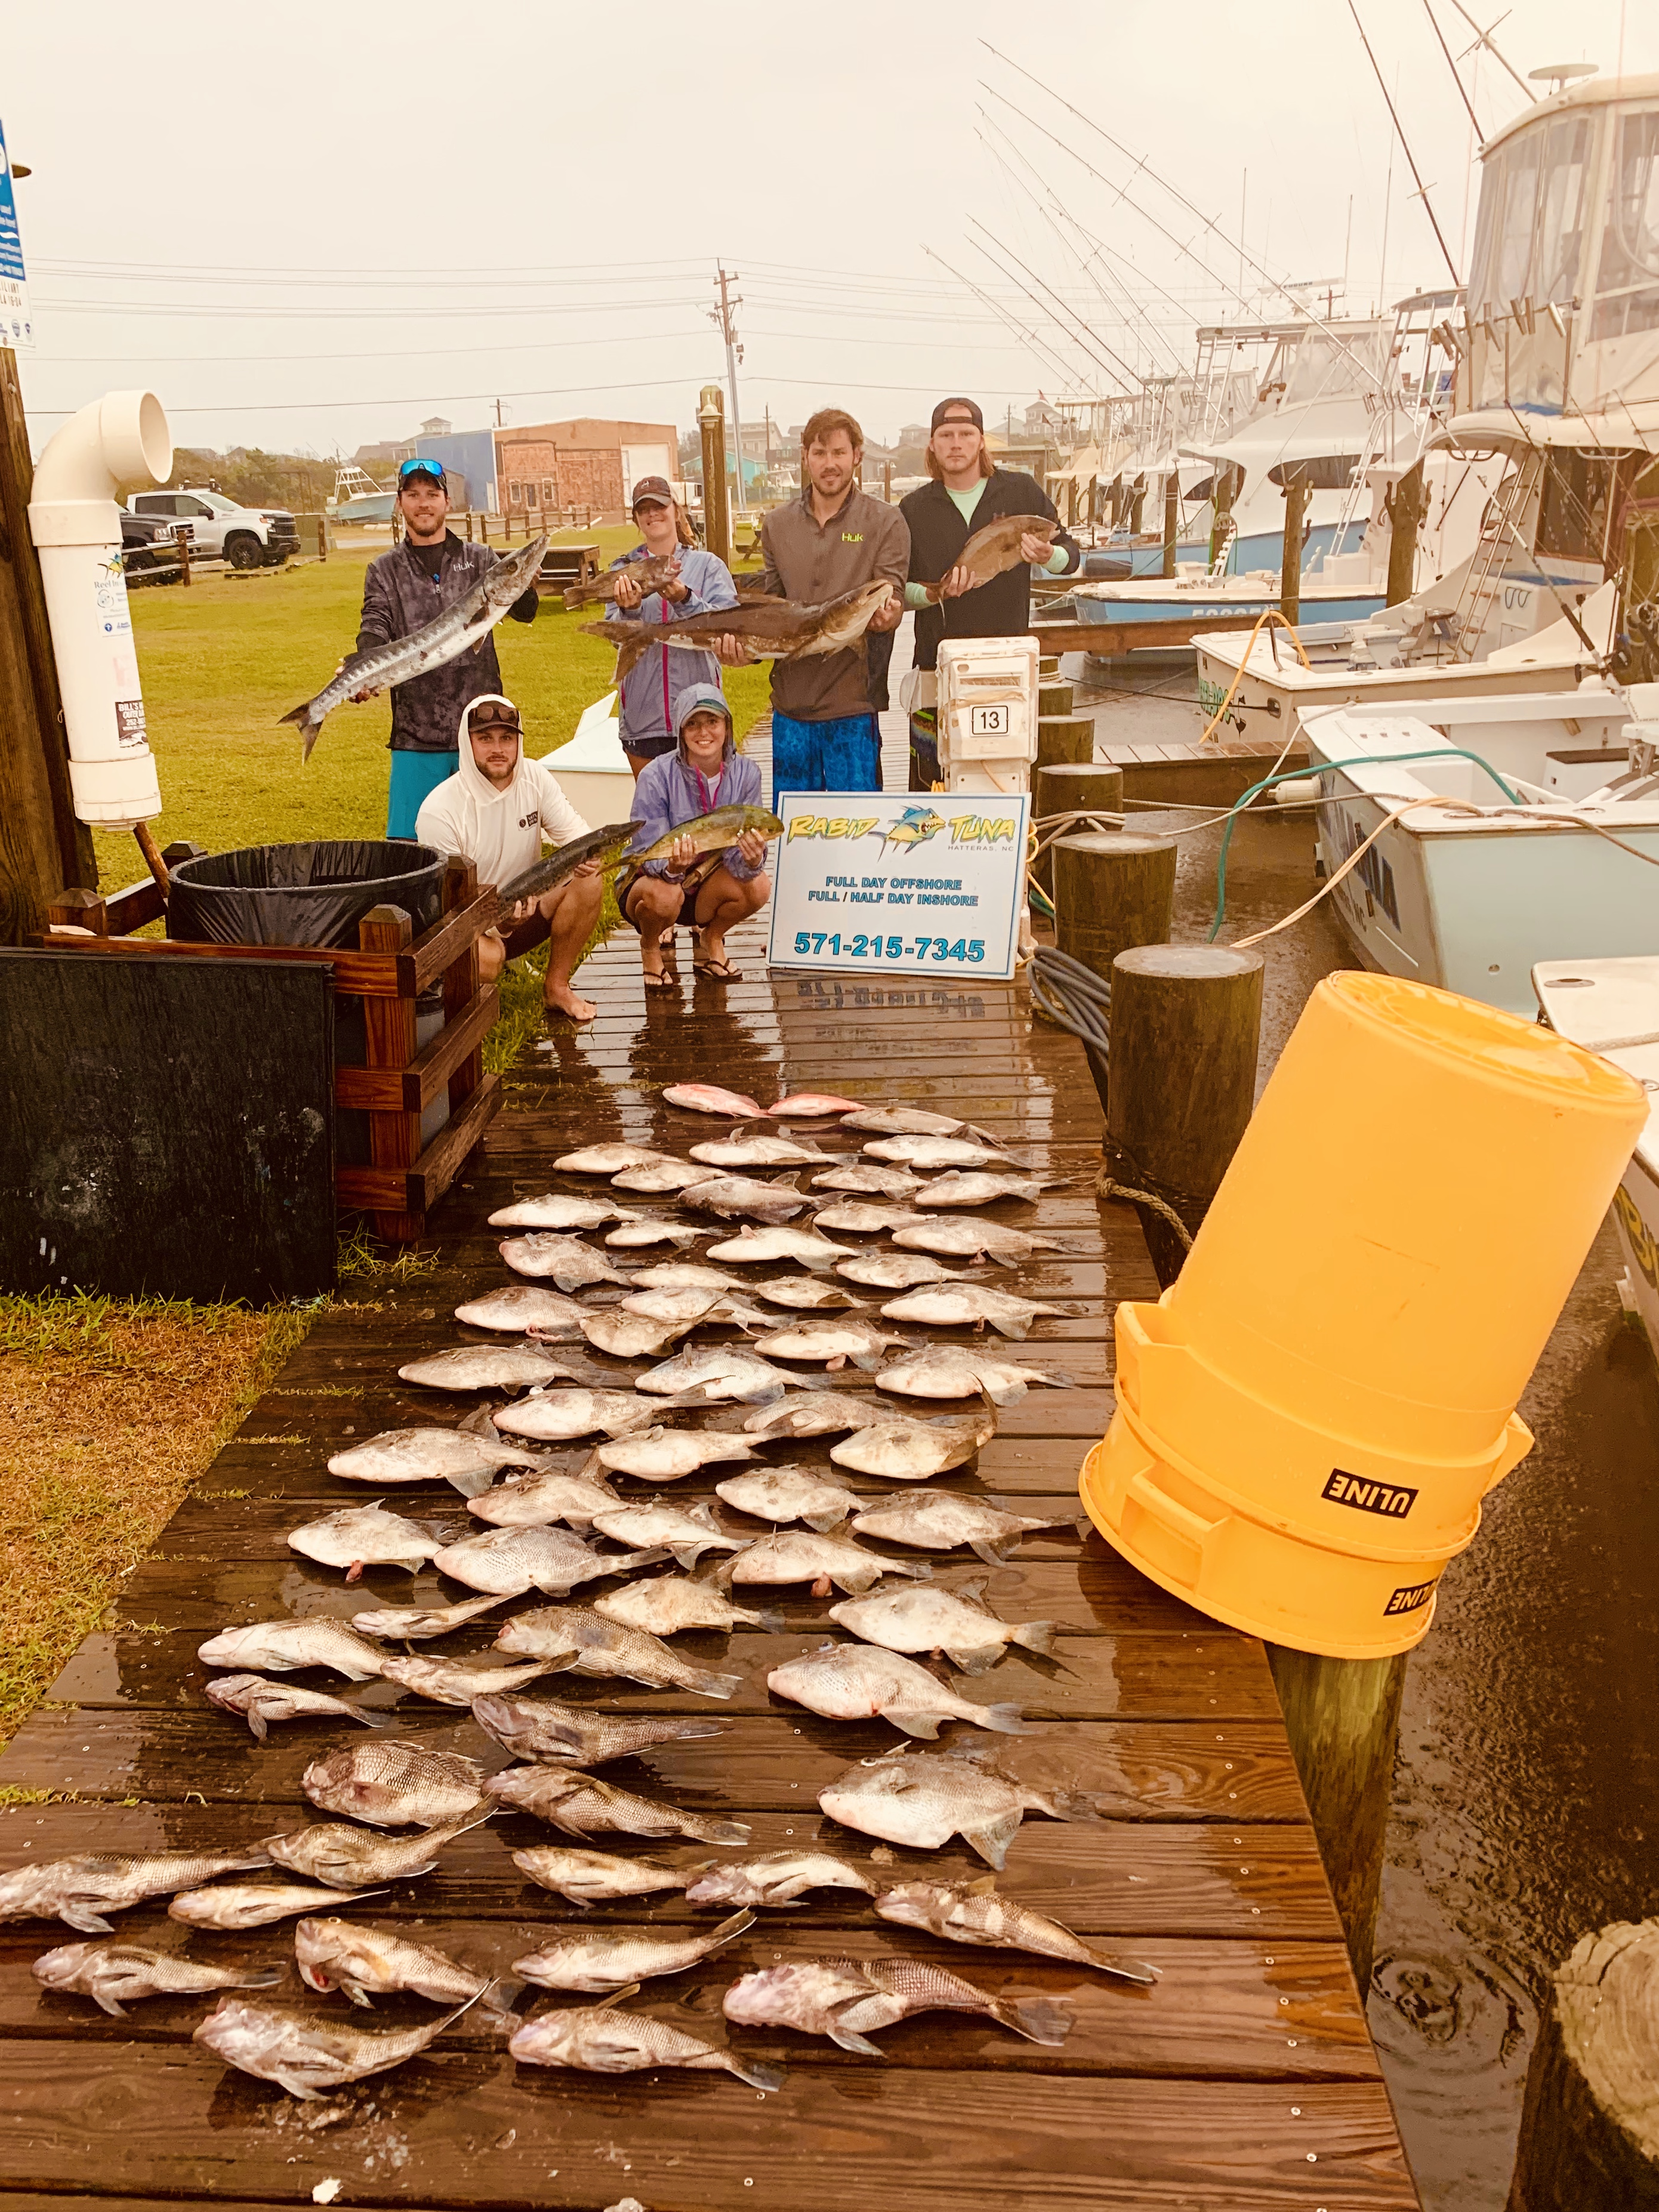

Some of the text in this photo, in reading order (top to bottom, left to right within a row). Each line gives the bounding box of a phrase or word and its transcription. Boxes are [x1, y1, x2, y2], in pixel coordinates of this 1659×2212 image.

[980, 711, 1000, 729] 13
[787, 815, 1015, 845] RABID TUNA
[826, 877, 962, 890] FULL DAY OFFSHORE
[808, 891, 979, 906] FULL / HALF DAY INSHORE
[794, 932, 985, 962] 571-215-7345
[1328, 1474, 1410, 1513] ULINE
